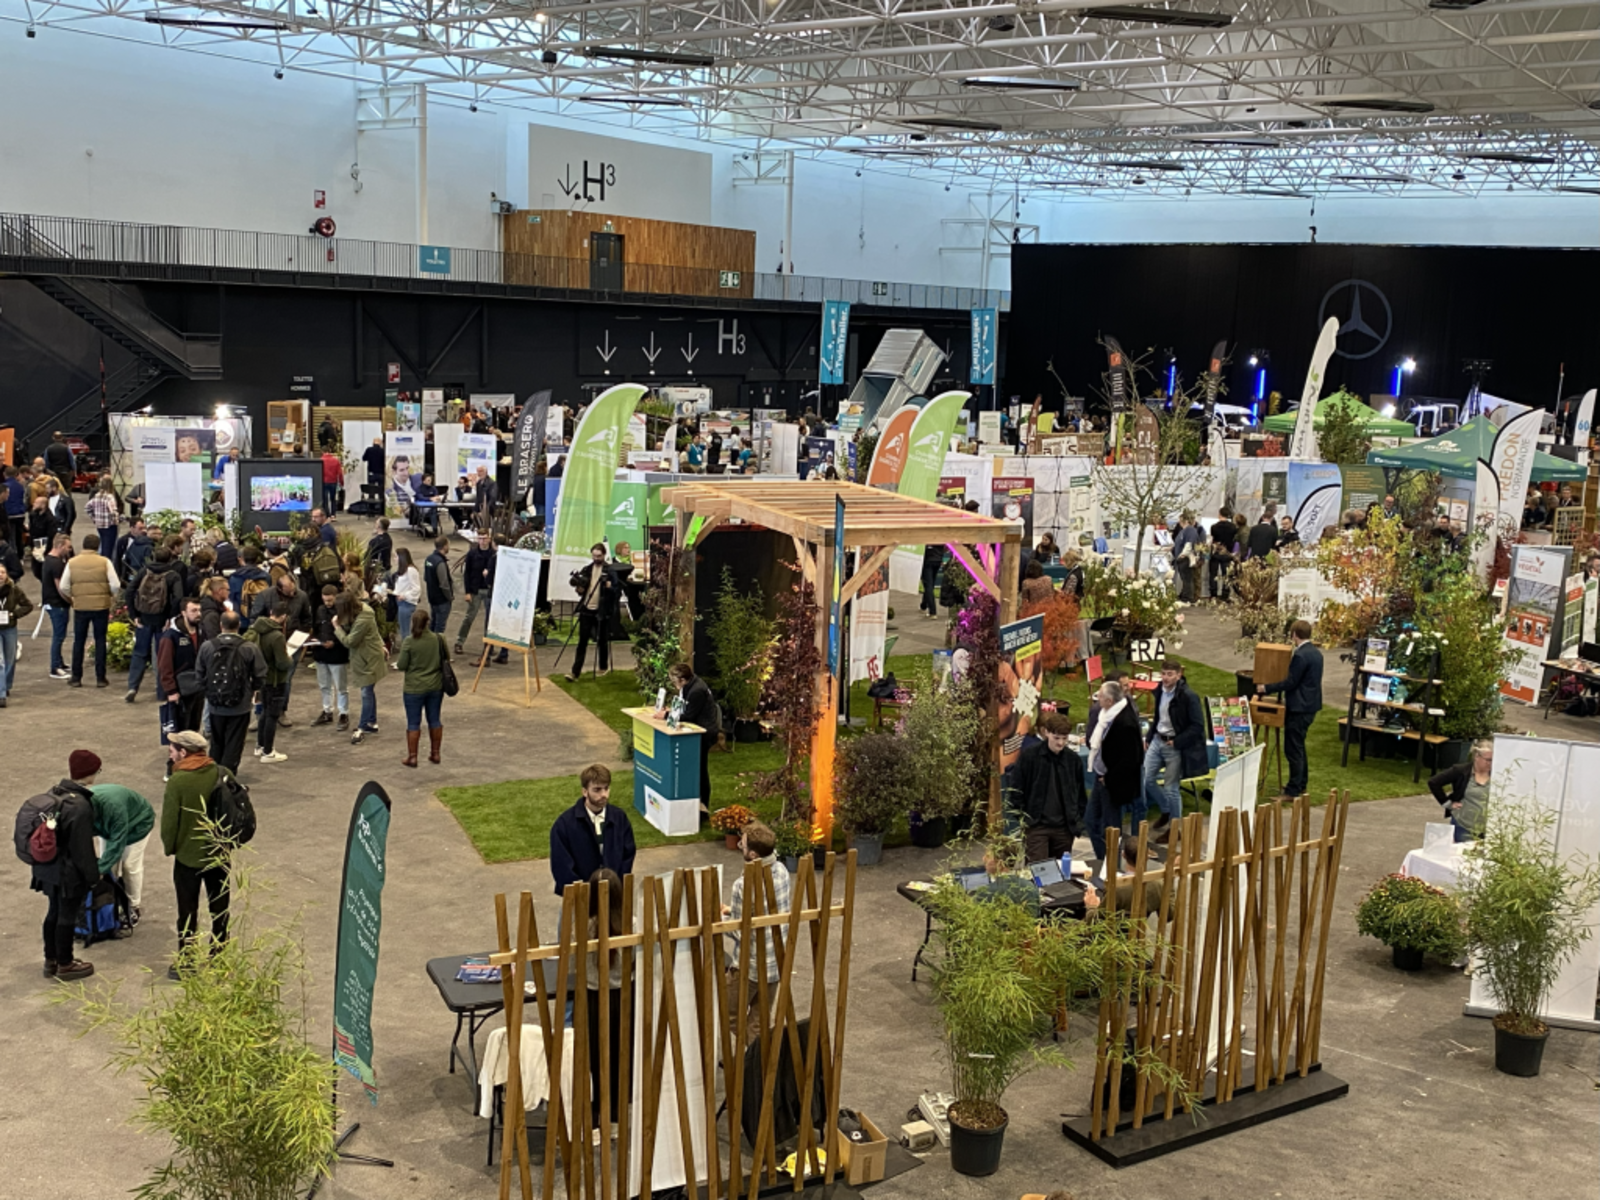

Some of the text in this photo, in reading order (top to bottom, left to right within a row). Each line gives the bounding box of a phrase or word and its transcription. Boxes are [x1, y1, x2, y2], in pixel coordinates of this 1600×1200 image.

[517, 414, 534, 495] LE BRASERO
[1578, 420, 1590, 432] 60
[1499, 432, 1522, 502] FREDON
[1511, 438, 1530, 499] NORMANDIE
